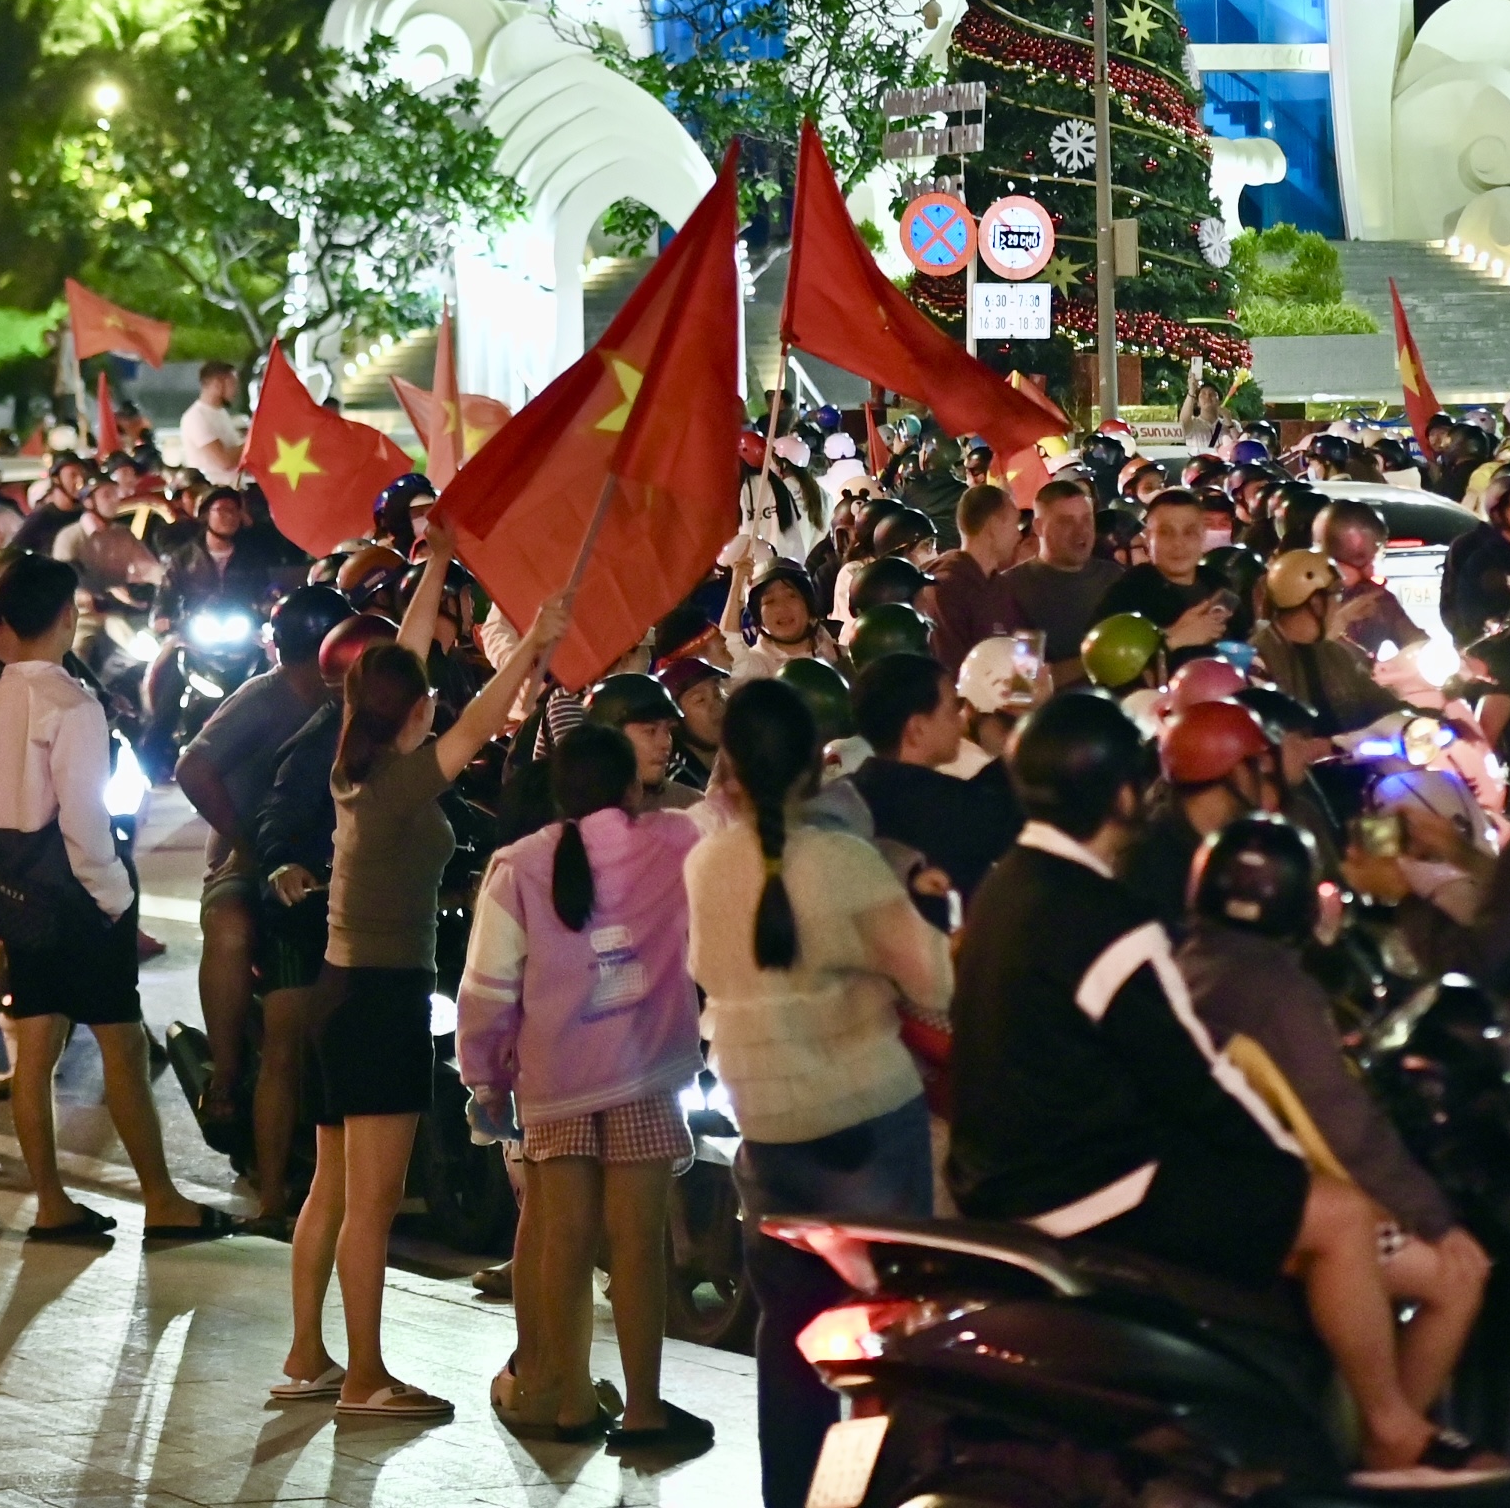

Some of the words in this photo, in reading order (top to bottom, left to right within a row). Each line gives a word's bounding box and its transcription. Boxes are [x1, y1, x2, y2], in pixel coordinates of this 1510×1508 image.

[1007, 234, 1019, 246] 29
[984, 294, 1007, 307] 6:30
[1018, 294, 1040, 307] 7:30
[979, 316, 1006, 330] 16:30
[1018, 316, 1045, 330] 18:30
[1161, 427, 1183, 438] TAXI
